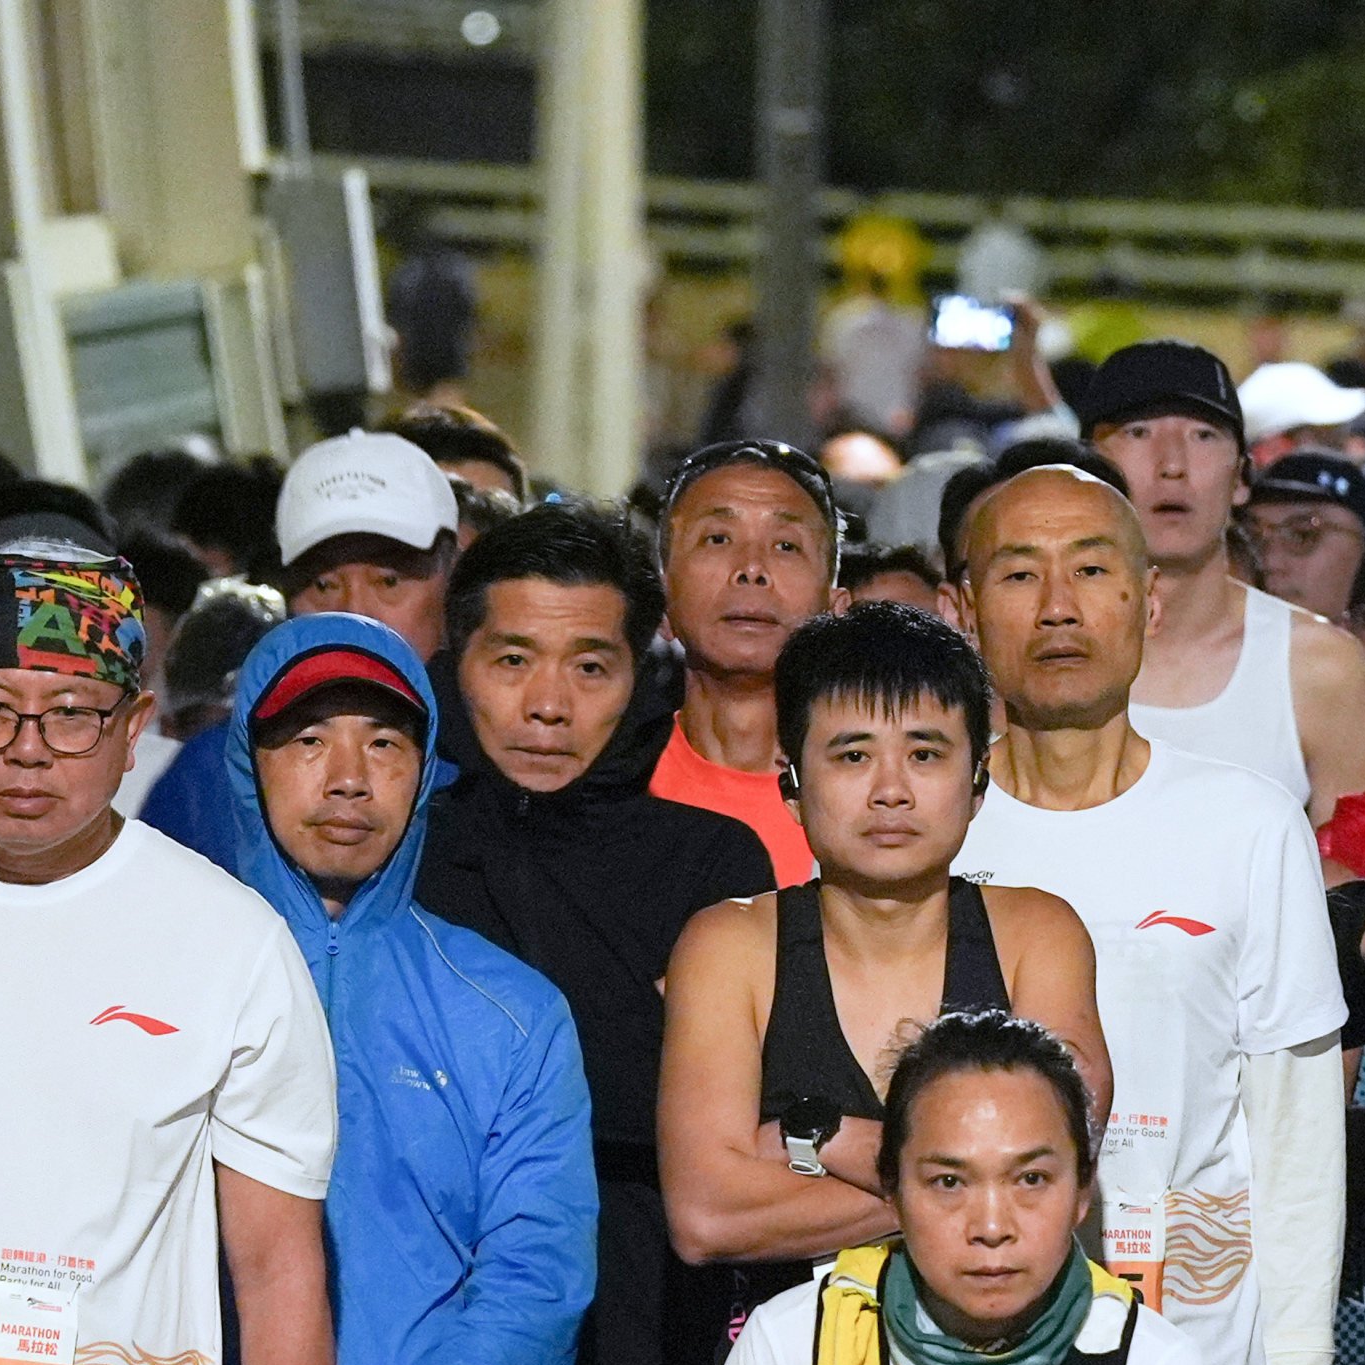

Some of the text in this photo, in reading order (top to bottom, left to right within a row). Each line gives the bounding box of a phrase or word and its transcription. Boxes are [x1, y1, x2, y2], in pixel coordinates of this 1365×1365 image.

[1126, 1128, 1139, 1136] for
[1122, 1138, 1133, 1148] All
[1115, 1241, 1151, 1254] 馬拉松
[0, 1263, 96, 1285] Marathon for Good,
[47, 1281, 61, 1290] All
[1, 1323, 60, 1341] MARATHON
[17, 1340, 58, 1356] 馬拉松
